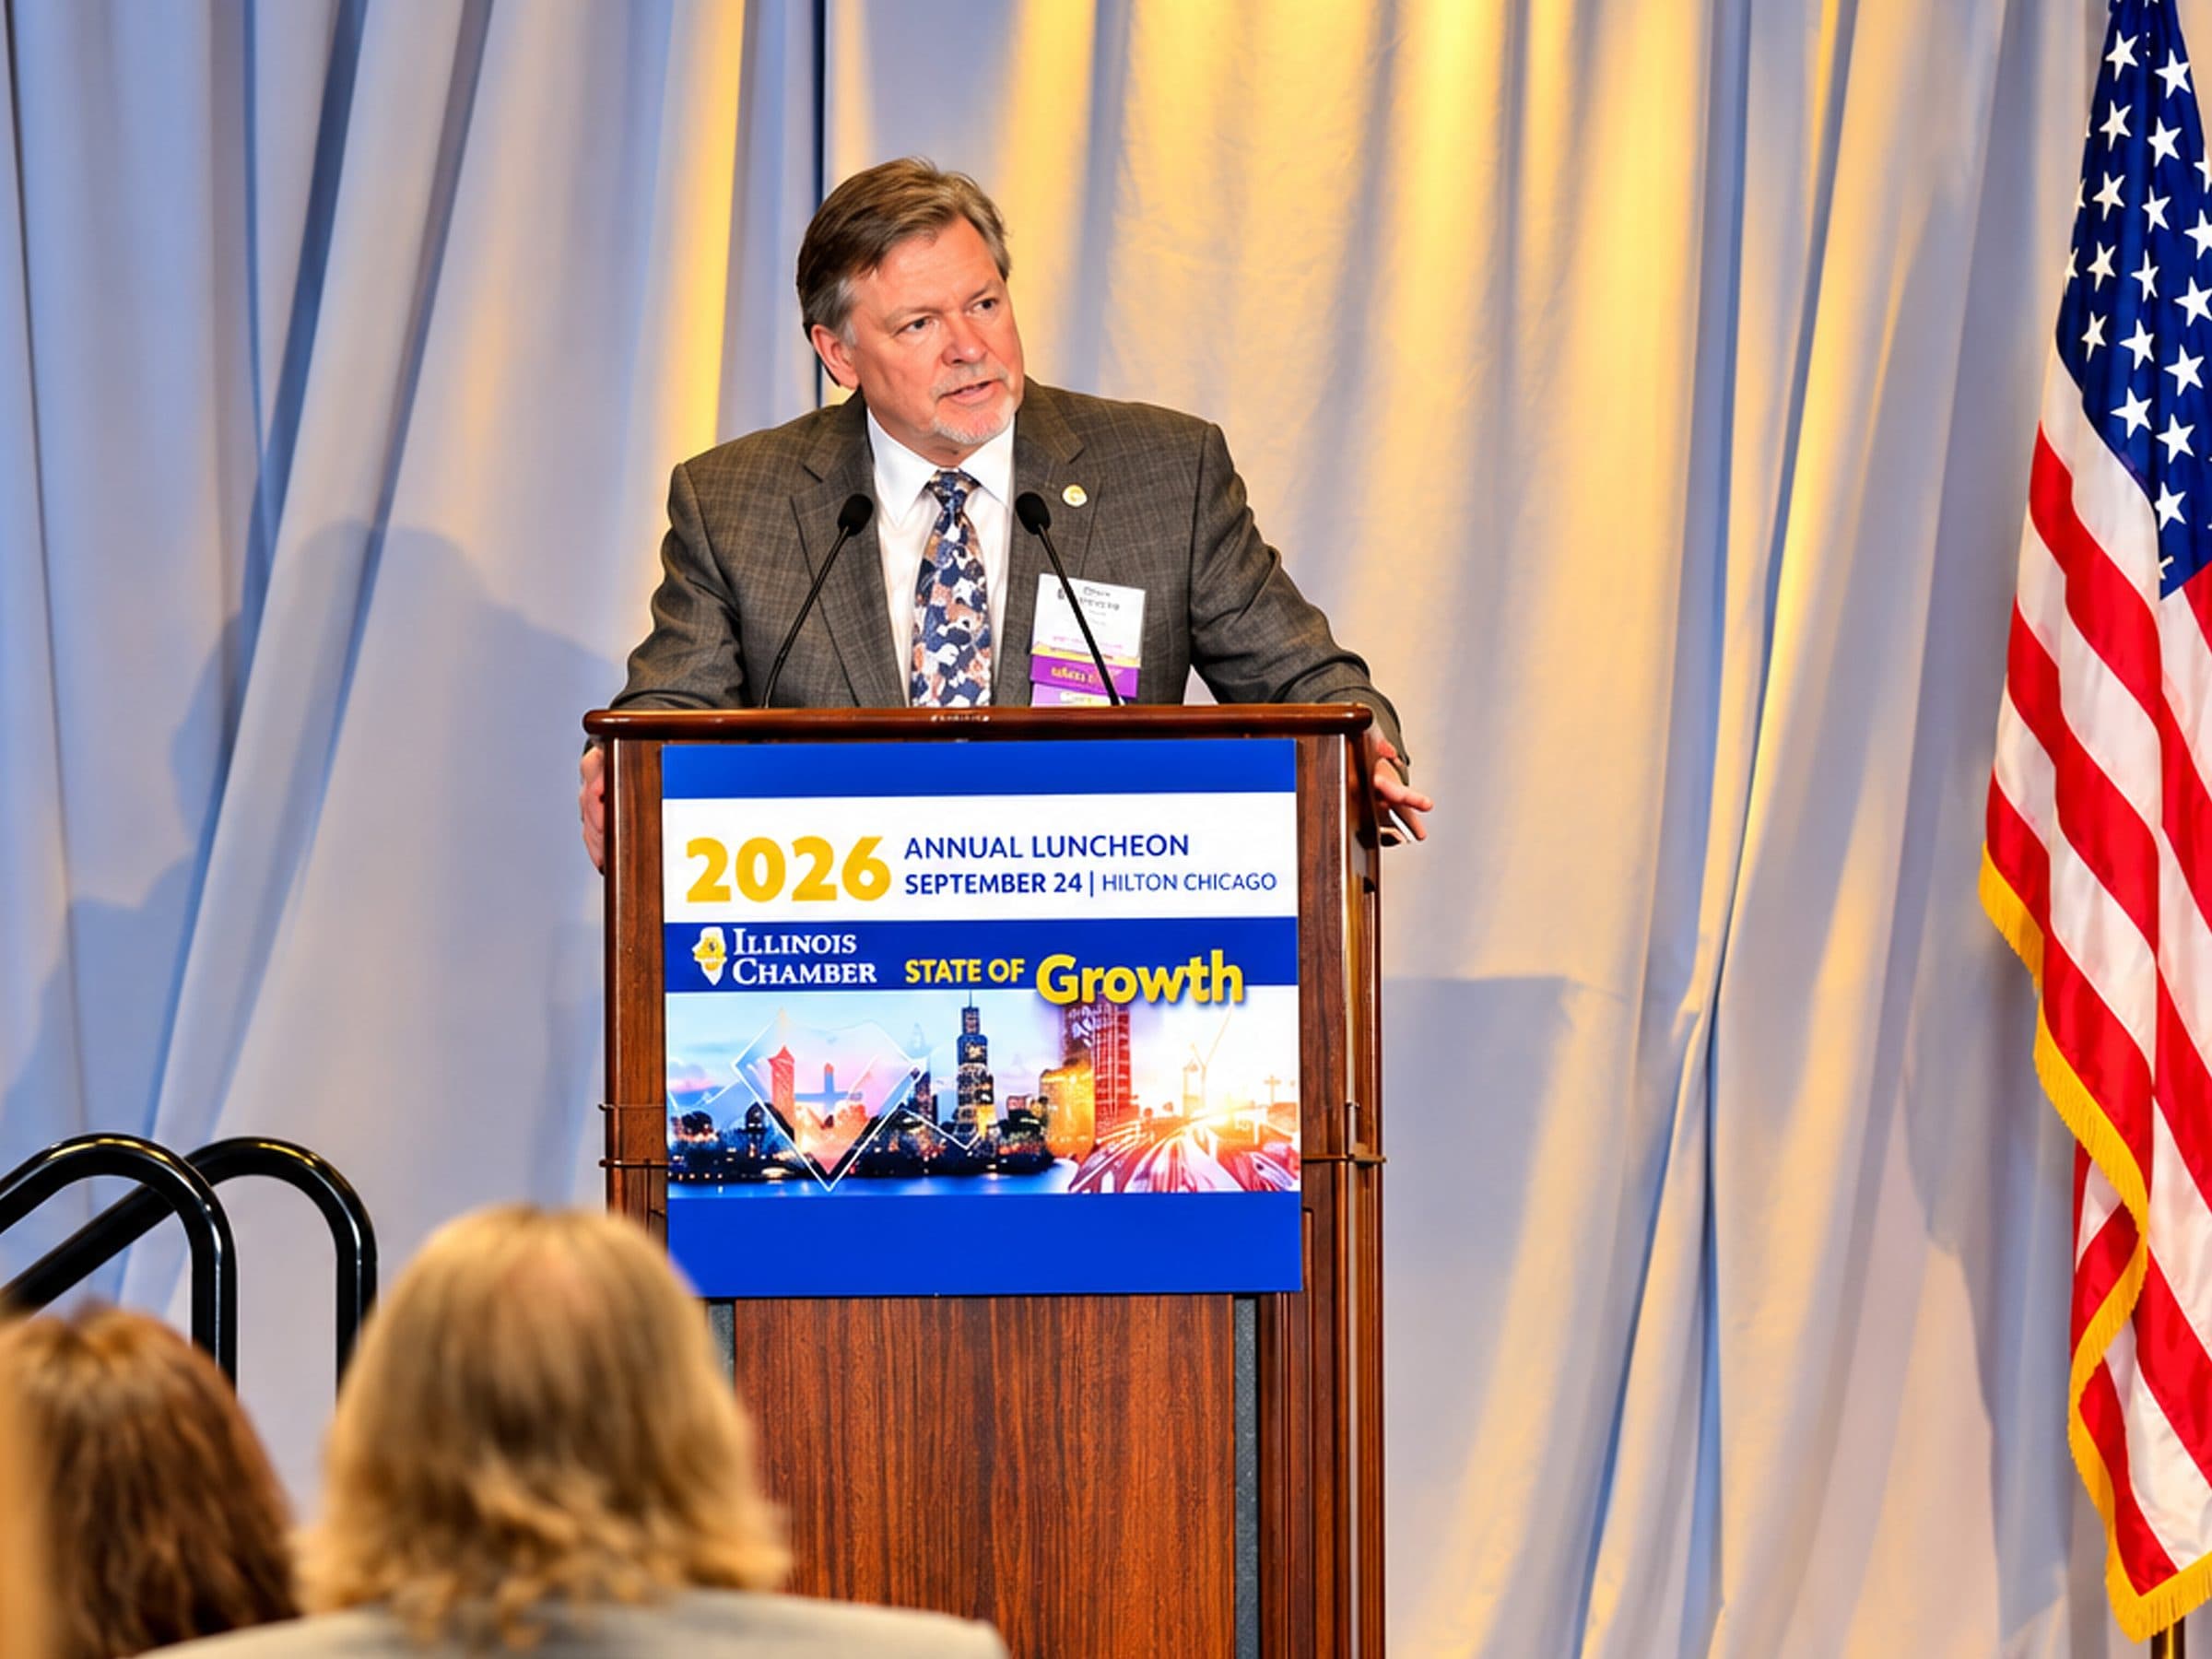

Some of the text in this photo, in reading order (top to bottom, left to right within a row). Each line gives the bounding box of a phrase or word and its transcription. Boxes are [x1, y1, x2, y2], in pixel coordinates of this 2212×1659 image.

[904, 834, 1189, 859] ANNUAL LUNCHEON
[686, 836, 891, 903] 2026
[905, 873, 1046, 895] SEPTEMBER
[1054, 873, 1082, 893] 24
[1102, 873, 1178, 891] HILTON
[1183, 872, 1277, 890] CHICAGO
[905, 948, 1243, 1005] STATE OF Growth
